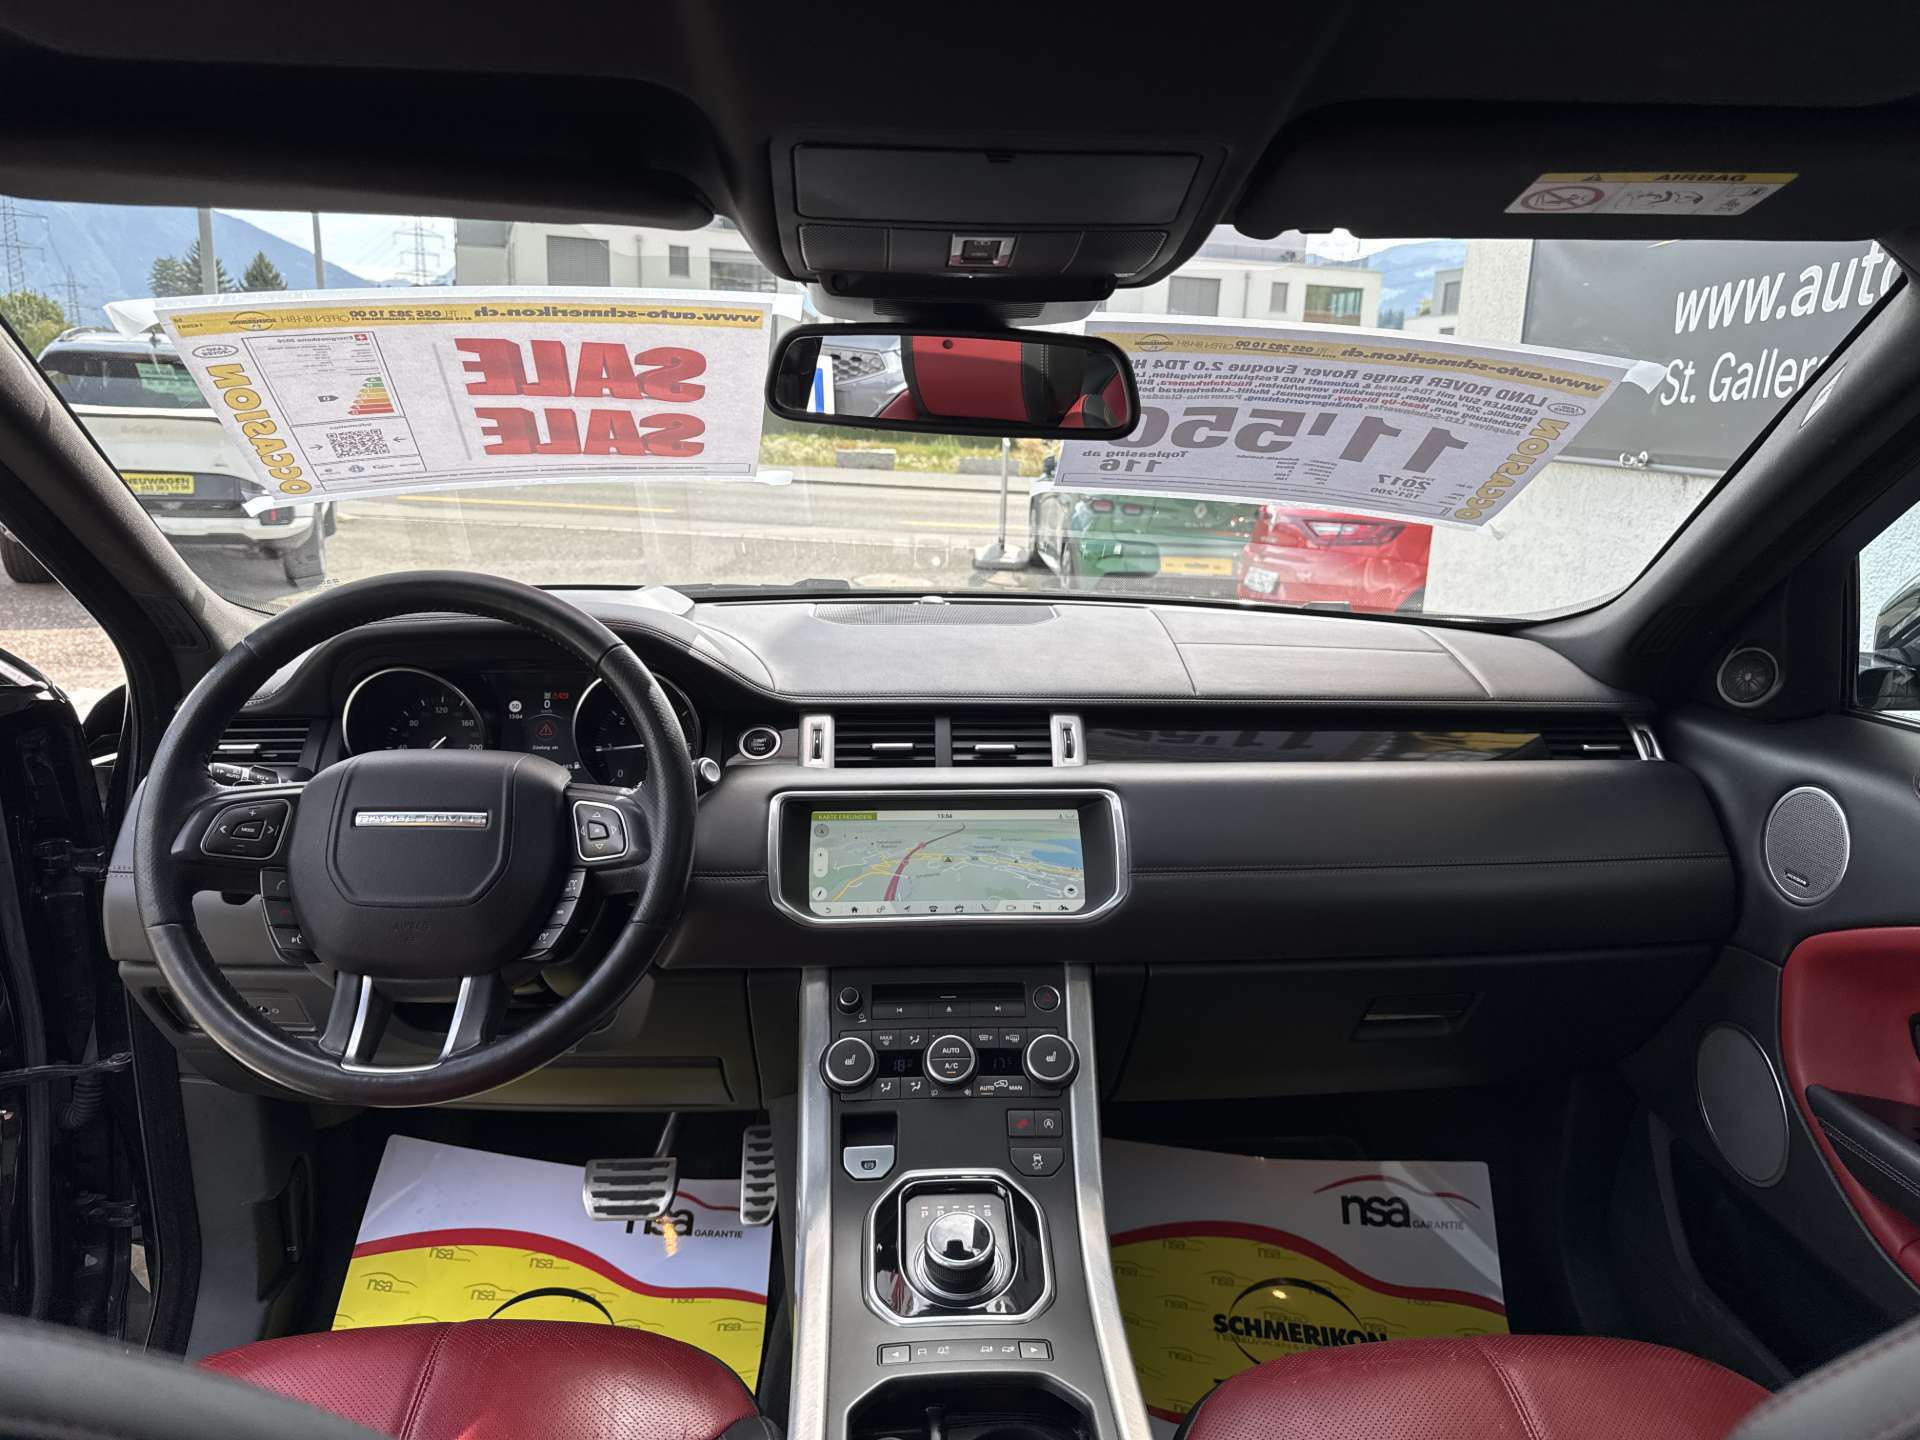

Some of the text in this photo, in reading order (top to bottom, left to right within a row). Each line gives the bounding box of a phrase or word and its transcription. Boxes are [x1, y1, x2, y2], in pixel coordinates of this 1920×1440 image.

[1655, 173, 1747, 182] AIRBAG
[1660, 358, 1695, 406] St.
[435, 706, 449, 714] 120
[544, 700, 551, 709] 0
[461, 719, 475, 727] 160
[619, 716, 626, 726] 2
[617, 769, 624, 778] 0
[1341, 1194, 1465, 1230] nsa GARANTIE
[694, 1229, 743, 1239] GARANTIE
[428, 1247, 454, 1261] nsa
[529, 1257, 555, 1270] nsa
[366, 1278, 393, 1293] nsa
[1210, 1276, 1235, 1287] nsa
[470, 1289, 496, 1301] nsa
[1164, 1298, 1189, 1311] nsa
[717, 1322, 742, 1333] nsa
[1213, 1313, 1390, 1348] SCHMERIKON
